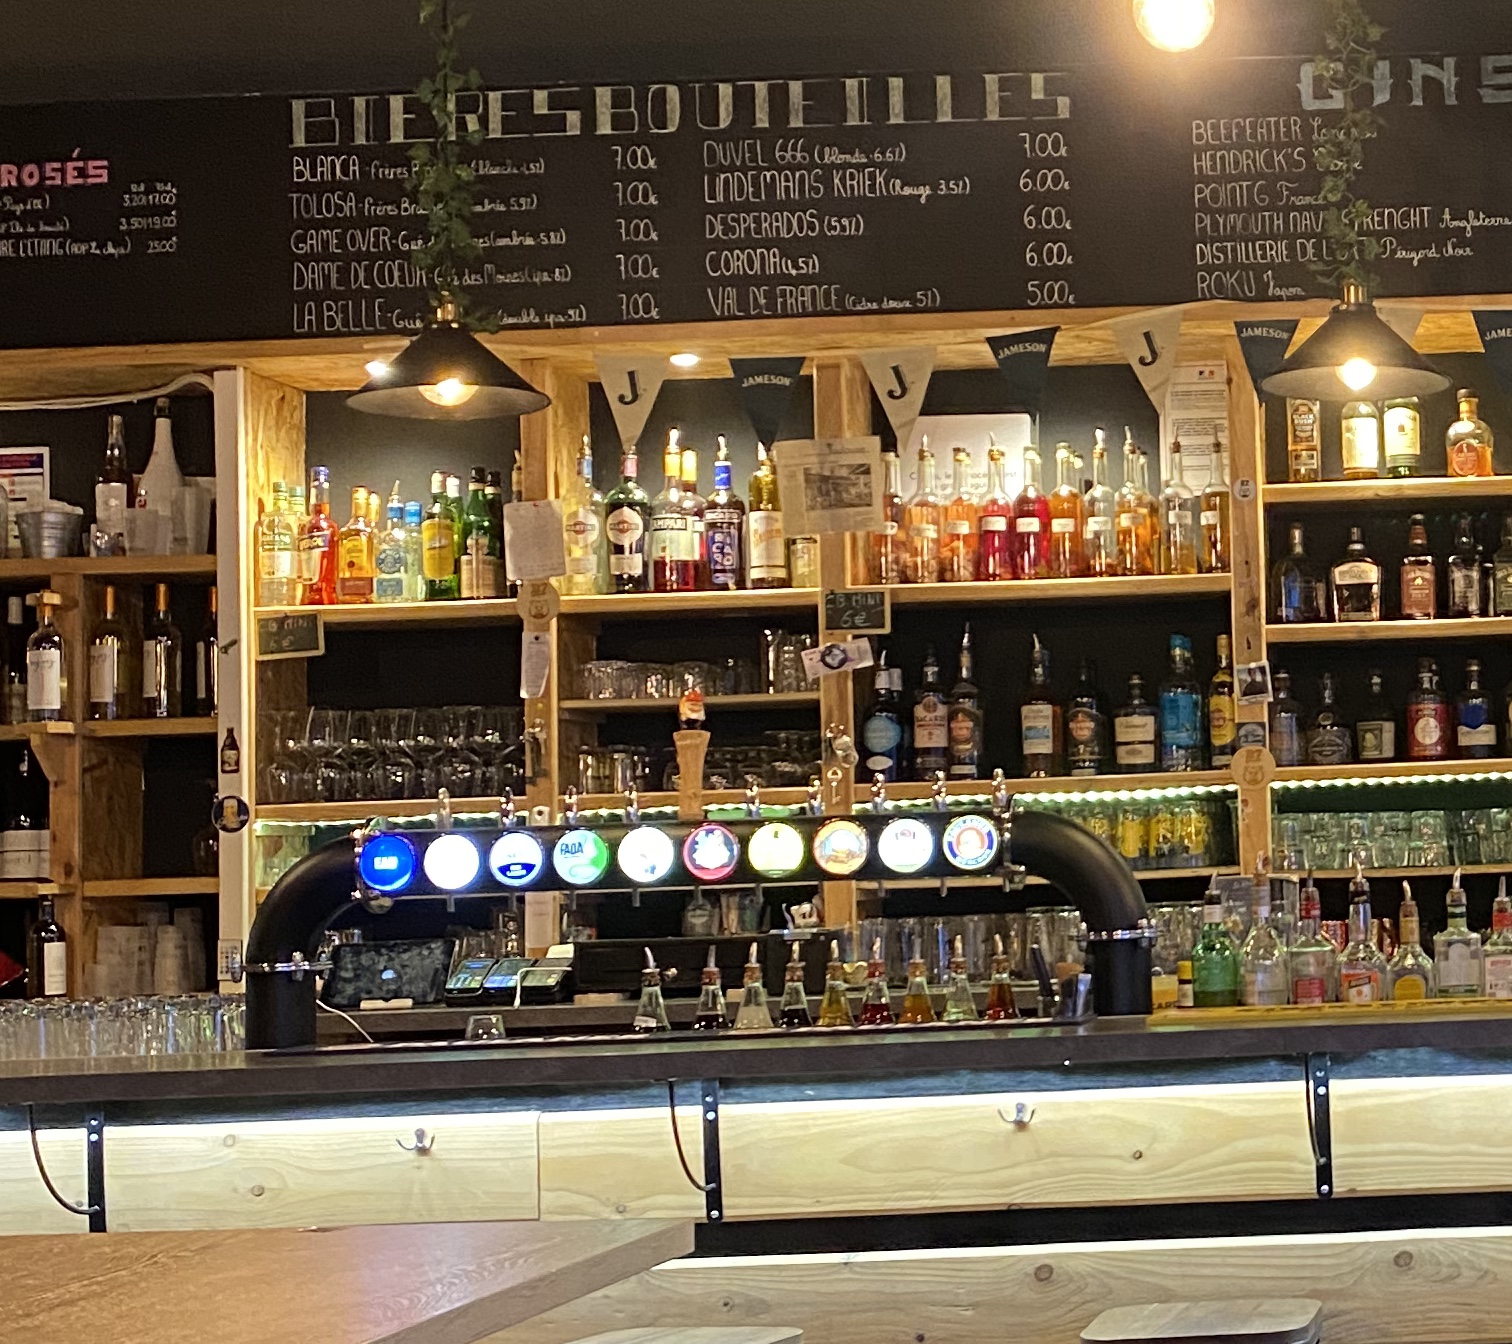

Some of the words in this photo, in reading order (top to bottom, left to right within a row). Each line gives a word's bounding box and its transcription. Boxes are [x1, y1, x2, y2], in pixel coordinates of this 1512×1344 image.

[289, 87, 580, 148] BIERES
[594, 72, 1070, 136] BOUTEILLES
[1192, 116, 1302, 145] BEEFEATER
[0, 147, 109, 187] ROSÉS
[292, 155, 360, 181] BLANCA
[611, 145, 658, 170] 7.00€
[704, 139, 769, 168] DUVEL
[775, 138, 809, 164] 666
[1018, 132, 1068, 158] 7.00€
[1193, 146, 1306, 175] HENDRICK'S
[289, 191, 356, 218] TOLOSA
[612, 182, 658, 206] 7.00€
[704, 168, 824, 203] LINDEMANS
[832, 167, 889, 197] KRIEK
[1019, 168, 1071, 193] 6.00€
[1194, 180, 1253, 208] POINT
[1254, 180, 1269, 206] G
[290, 229, 342, 254] GAME
[346, 226, 392, 252] OVER
[615, 218, 659, 242] 7.00€
[705, 209, 820, 240] DESPERADOS
[1023, 204, 1072, 230] 6.00€
[1195, 211, 1284, 236] PLYMOUTH
[1289, 211, 1324, 233] NAV
[1438, 206, 1512, 237] Angleterre
[705, 247, 782, 277] CORONA
[1025, 241, 1074, 267] 6.00€
[1195, 239, 1291, 265] DISTILLERIE
[1296, 238, 1318, 262] DE
[1442, 237, 1474, 256] Noir
[293, 260, 345, 291] DAME
[351, 260, 371, 289] DE
[615, 254, 660, 280] 7.00€
[1196, 269, 1256, 299] ROKU
[1262, 269, 1306, 301] Japon
[293, 301, 317, 332] LA
[323, 298, 388, 332] BELLE
[618, 292, 660, 320] 7.00€
[706, 286, 746, 316] VAL
[750, 286, 773, 316] DE
[775, 284, 843, 313] FRANCE
[1026, 279, 1076, 306] 5.00€
[998, 342, 1048, 359] JAMESON
[1137, 330, 1160, 367] J
[1239, 326, 1290, 340] JAMESON
[617, 369, 641, 406] J
[740, 373, 794, 388] JAMESON
[886, 364, 909, 401] J
